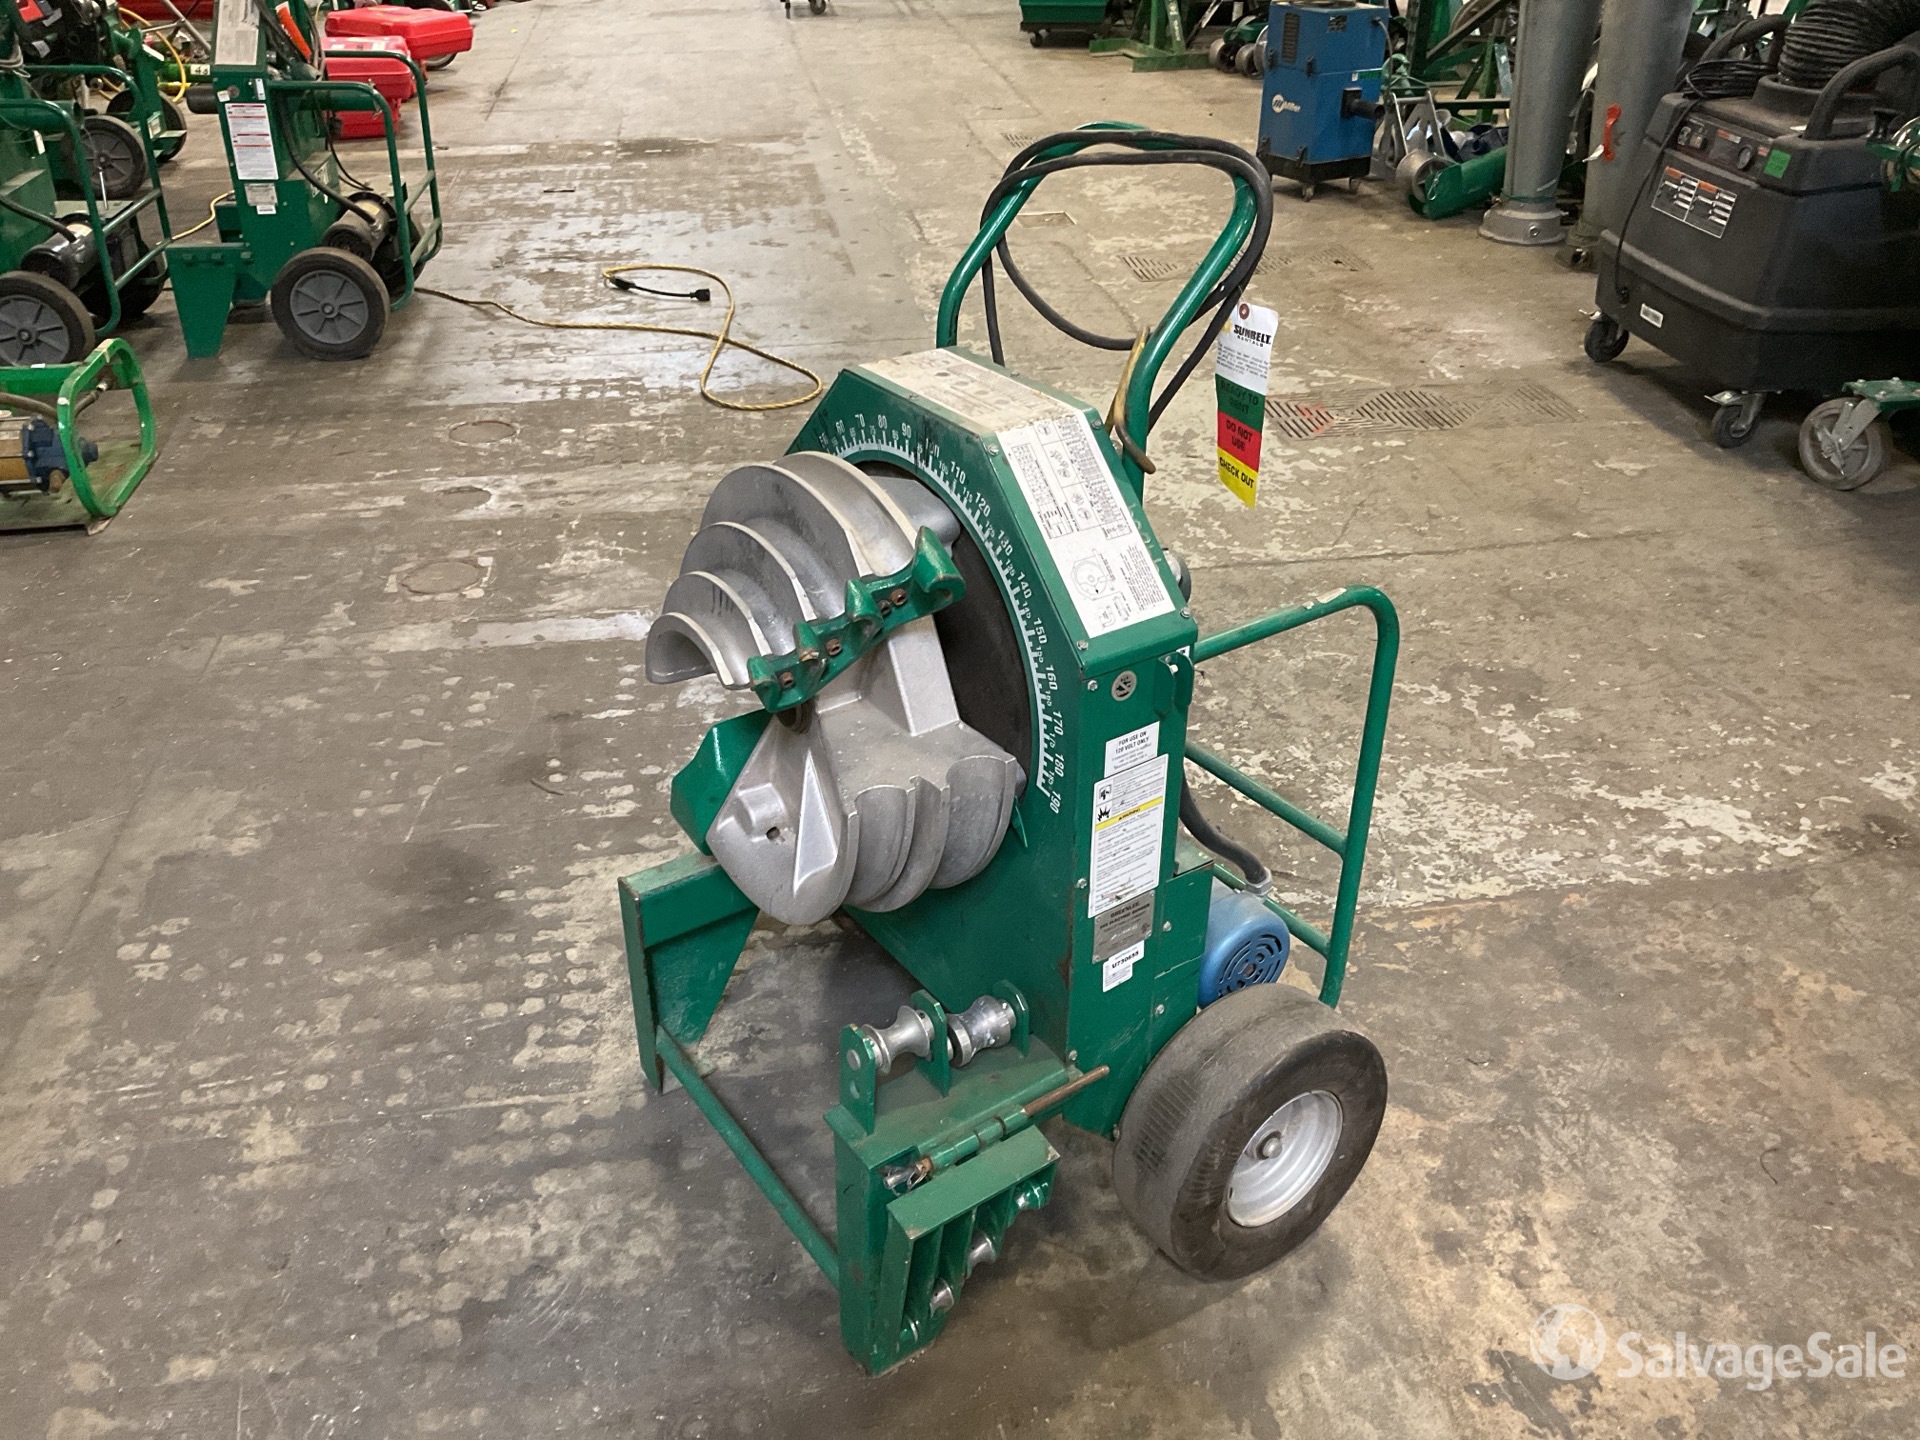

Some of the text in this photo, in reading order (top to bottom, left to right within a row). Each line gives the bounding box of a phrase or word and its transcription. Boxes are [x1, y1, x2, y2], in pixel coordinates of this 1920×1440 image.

[1233, 324, 1271, 345] SUNBELT
[854, 413, 866, 428] 70
[877, 414, 888, 429] 80
[901, 422, 912, 439] 90
[1226, 420, 1253, 442] DO NOT
[1231, 435, 1246, 452] USE
[951, 461, 966, 484] 110
[1219, 457, 1255, 489] CHECK OUT
[962, 486, 973, 503] 115
[975, 492, 991, 517] 120
[997, 529, 1013, 556] 130
[1017, 571, 1033, 599] 140
[1033, 617, 1048, 644] 150
[1045, 664, 1058, 690] 160
[1052, 710, 1064, 736] 170
[1124, 741, 1137, 750] VOLT
[1137, 736, 1150, 746] ONLY
[1054, 753, 1065, 778] 180
[1049, 791, 1062, 814] 190
